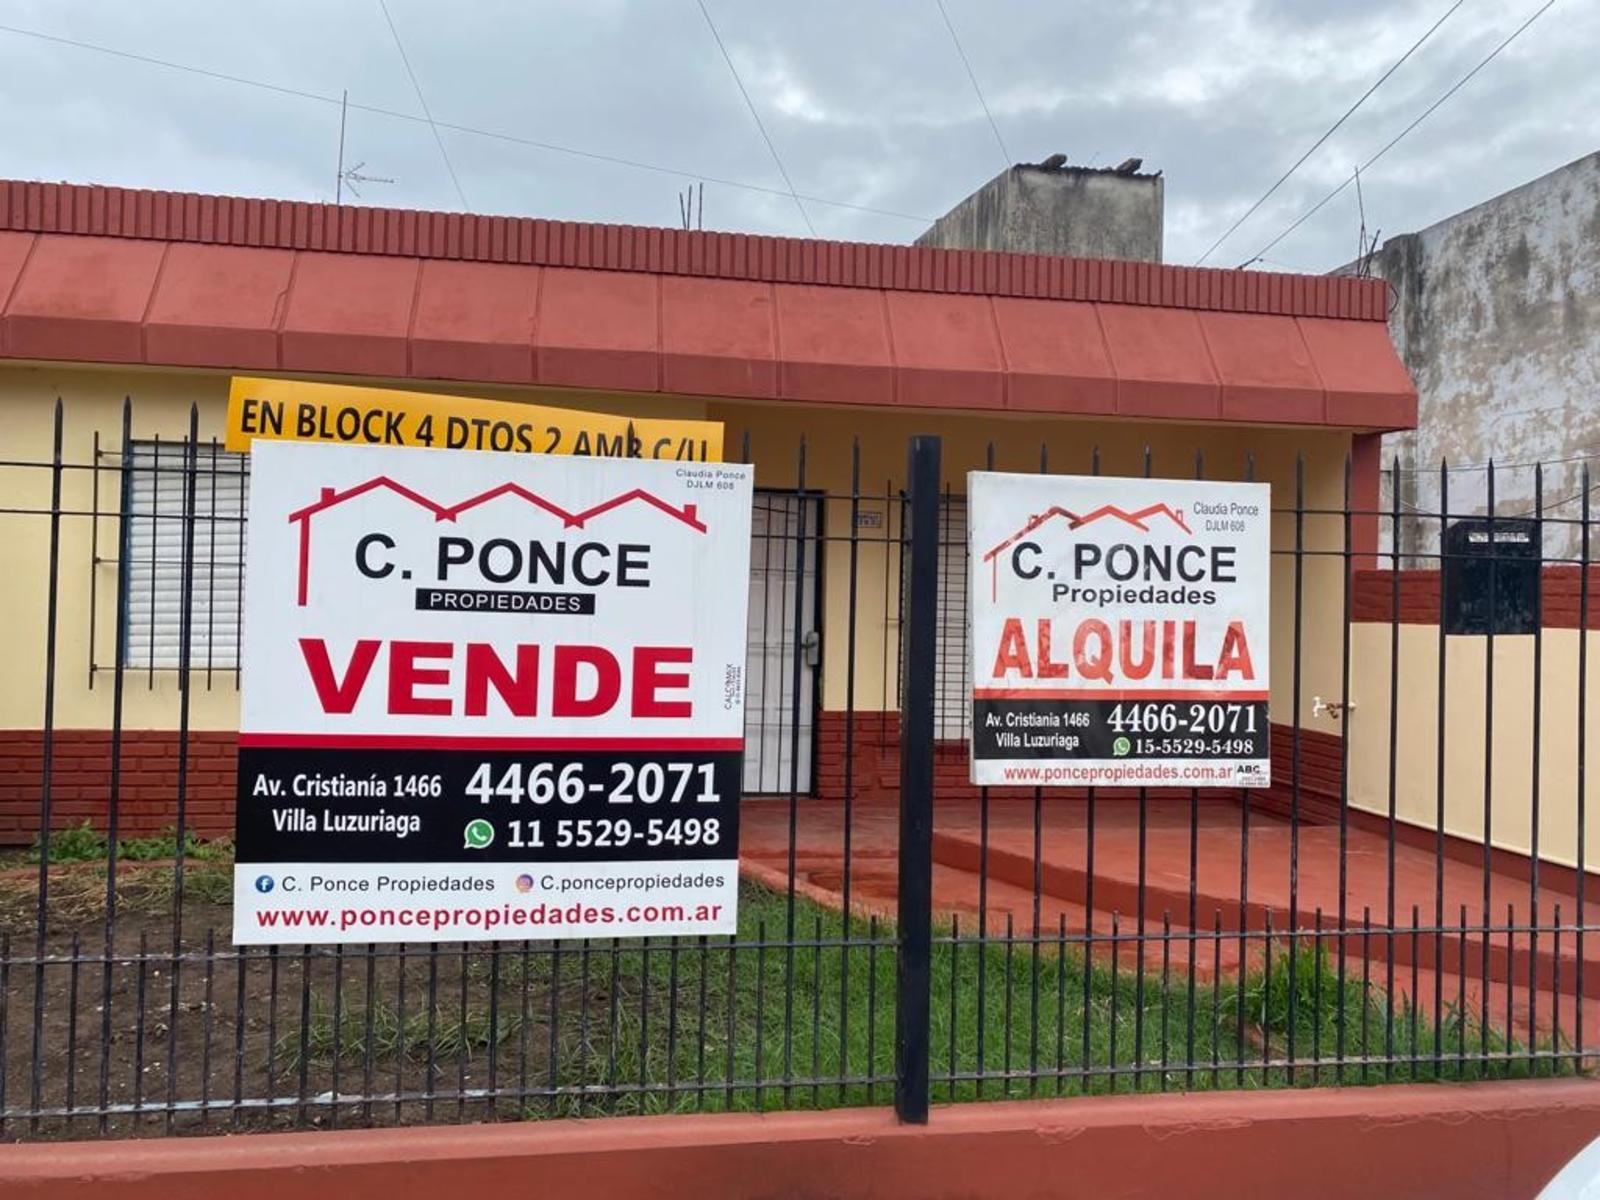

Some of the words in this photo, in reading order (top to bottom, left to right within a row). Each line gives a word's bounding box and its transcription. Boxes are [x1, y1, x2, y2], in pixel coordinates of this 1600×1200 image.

[240, 399, 284, 435] EN
[296, 403, 405, 445] BLOCK
[415, 415, 434, 447] 4
[447, 416, 533, 453] DTOS
[545, 426, 562, 453] 2
[675, 468, 713, 478] Claudia
[716, 470, 746, 479] Ponce
[687, 480, 713, 489] DJLM
[1193, 501, 1228, 515] Claudia
[1231, 502, 1259, 516] Ponce
[1206, 520, 1229, 531] DJLM
[355, 533, 412, 580] C.
[437, 536, 652, 588] PONCE
[1012, 541, 1055, 580] C.
[1074, 543, 1237, 583] PONCE
[430, 592, 581, 612] PROPIEDADES
[1052, 583, 1216, 607] Propiedades
[992, 618, 1255, 685] ALQUILA
[299, 638, 693, 718] VENDE
[986, 712, 1003, 727] Av.
[1006, 712, 1060, 727] Cristiania
[1063, 712, 1090, 727] 1466
[1107, 703, 1257, 734] 4466-2071
[995, 732, 1020, 747] Villa
[1024, 733, 1079, 750] Luzuriaga
[1136, 739, 1254, 754] 15-5529-5498
[465, 763, 721, 805] 4466-2071
[1004, 762, 1233, 782] www.poncepropiedades.com.ar
[253, 774, 286, 796] Av.
[293, 773, 387, 797] Cristianía
[393, 775, 442, 797] 1466
[272, 808, 317, 832] Villa
[323, 809, 421, 838] Luzuriaga
[508, 821, 544, 848] 11
[556, 818, 720, 848] 5529-5498
[282, 876, 302, 892] C.
[310, 876, 370, 892] Ponce
[378, 875, 495, 894] Propiedades
[541, 873, 724, 893] C.poncepropiedades
[256, 903, 723, 931] www.poncepropiedades.com.ar
